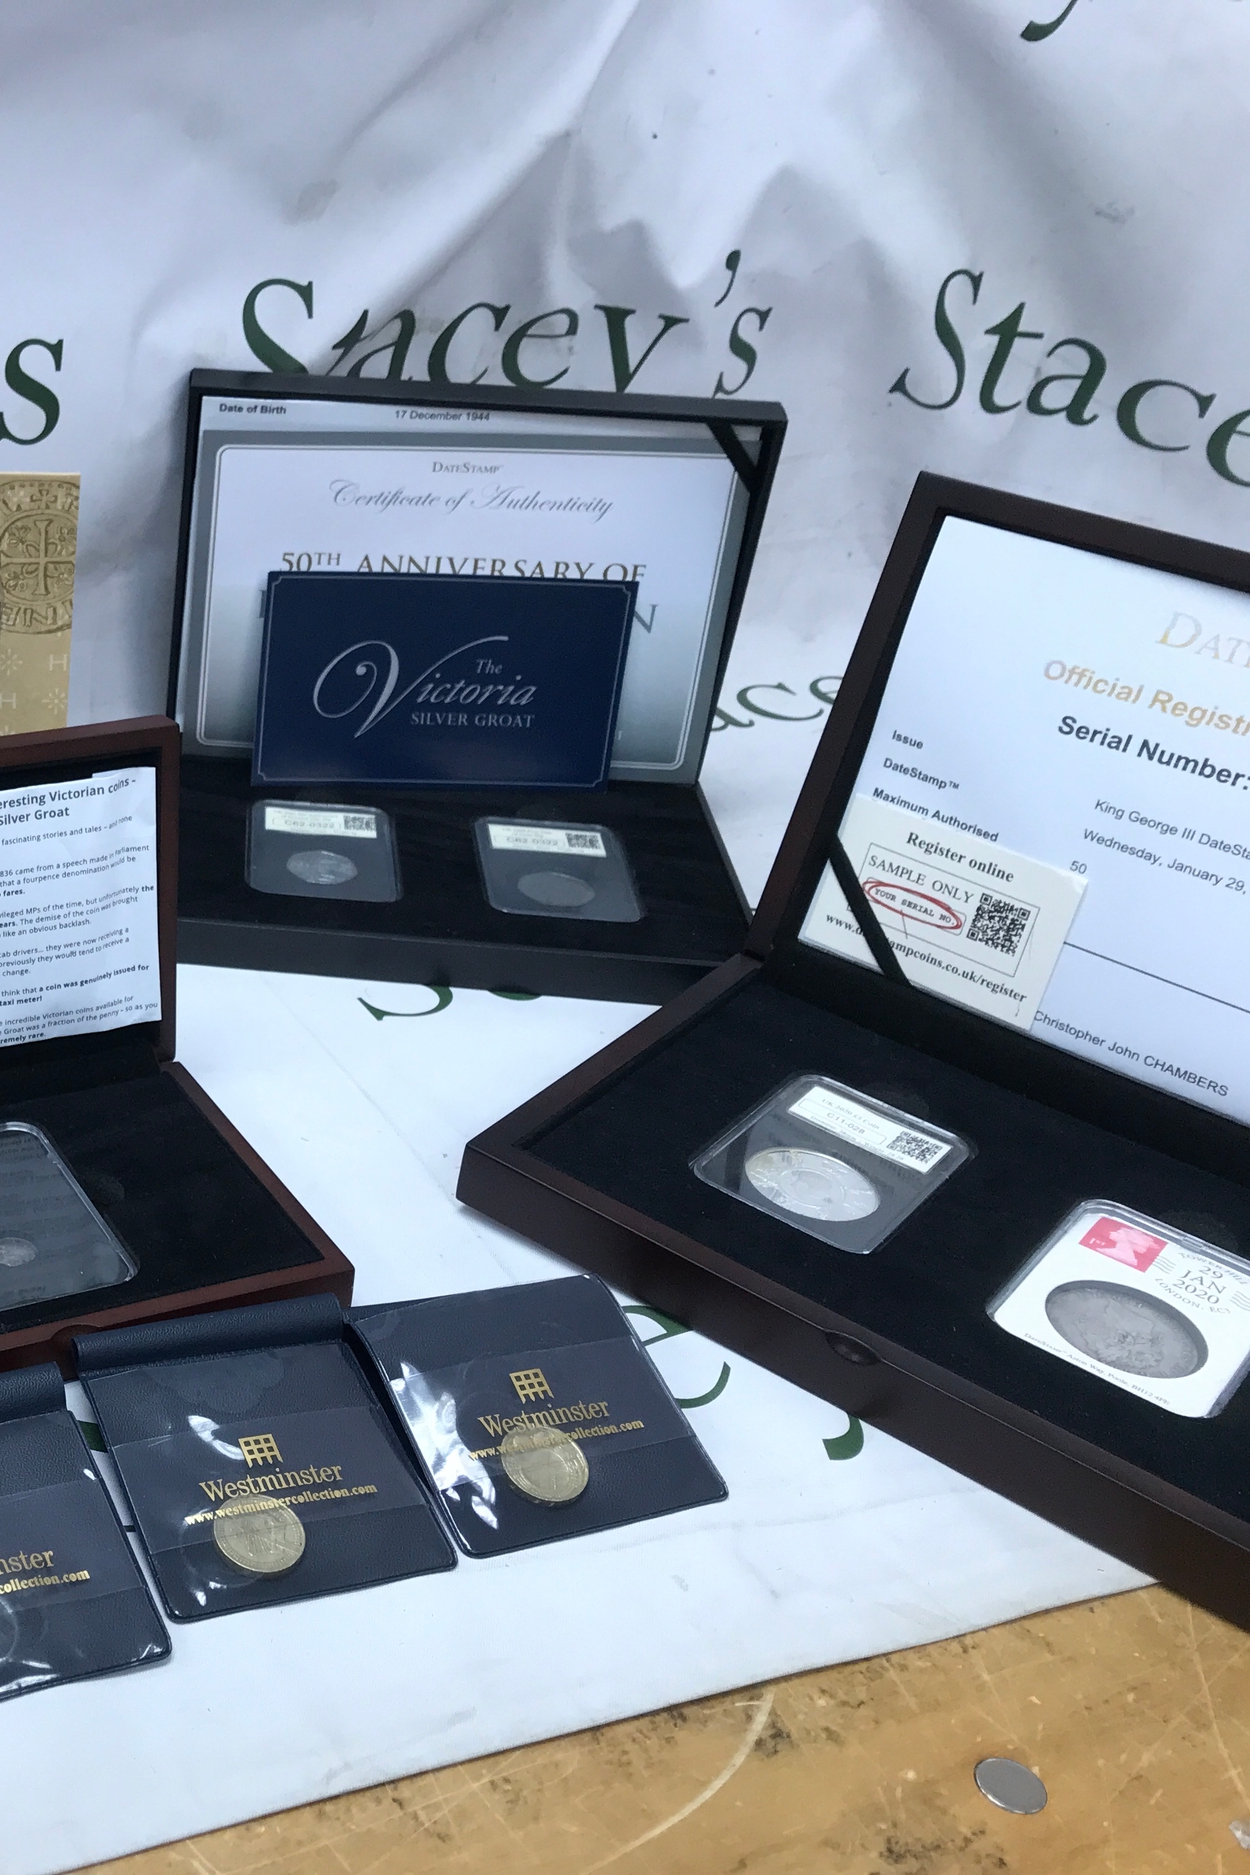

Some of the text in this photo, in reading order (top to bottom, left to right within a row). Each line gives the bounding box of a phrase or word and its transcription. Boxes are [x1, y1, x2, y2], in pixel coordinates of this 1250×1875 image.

[219, 402, 287, 415] Date of Birth
[395, 409, 491, 421] 17 December 1944
[329, 479, 614, 524] Certificate of Authenticity
[357, 553, 594, 580] ANNIVERSARY
[1156, 610, 1250, 669] DAT
[475, 658, 504, 677] The
[1044, 659, 1145, 705] Official
[313, 635, 538, 739] Victoria
[411, 711, 536, 729] SILVER GROAT
[1058, 715, 1133, 753] Serial
[892, 730, 924, 750] Issue
[49, 786, 104, 802] Victorian
[108, 778, 129, 793] coins
[34, 807, 69, 820] Groat
[872, 787, 1000, 843] Maximum Authorised
[1095, 799, 1125, 821] King
[1128, 810, 1178, 837] George
[1181, 827, 1197, 842] III
[906, 831, 1015, 883] Register online
[1069, 860, 1089, 876] 50
[1083, 828, 1248, 895] Wednesday, January 29,
[3, 888, 26, 897] fares.
[868, 854, 975, 905] SAMPLE ONLY
[874, 888, 955, 926] YOUR SERIAL NO.
[46, 983, 62, 991] coin
[80, 971, 112, 987] genuinely
[114, 965, 136, 976] issued
[0, 998, 14, 1006] taxi
[16, 995, 43, 1006] meter!
[1033, 1010, 1230, 1098] Christopher John CHAMBERS
[1181, 1269, 1228, 1295] JAN
[1198, 1265, 1225, 1281] 29
[1172, 1279, 1221, 1306] 2020
[477, 1400, 611, 1438] Westminster
[198, 1464, 343, 1502] Westminster
[184, 1483, 378, 1526] www.westminstercollection.com
